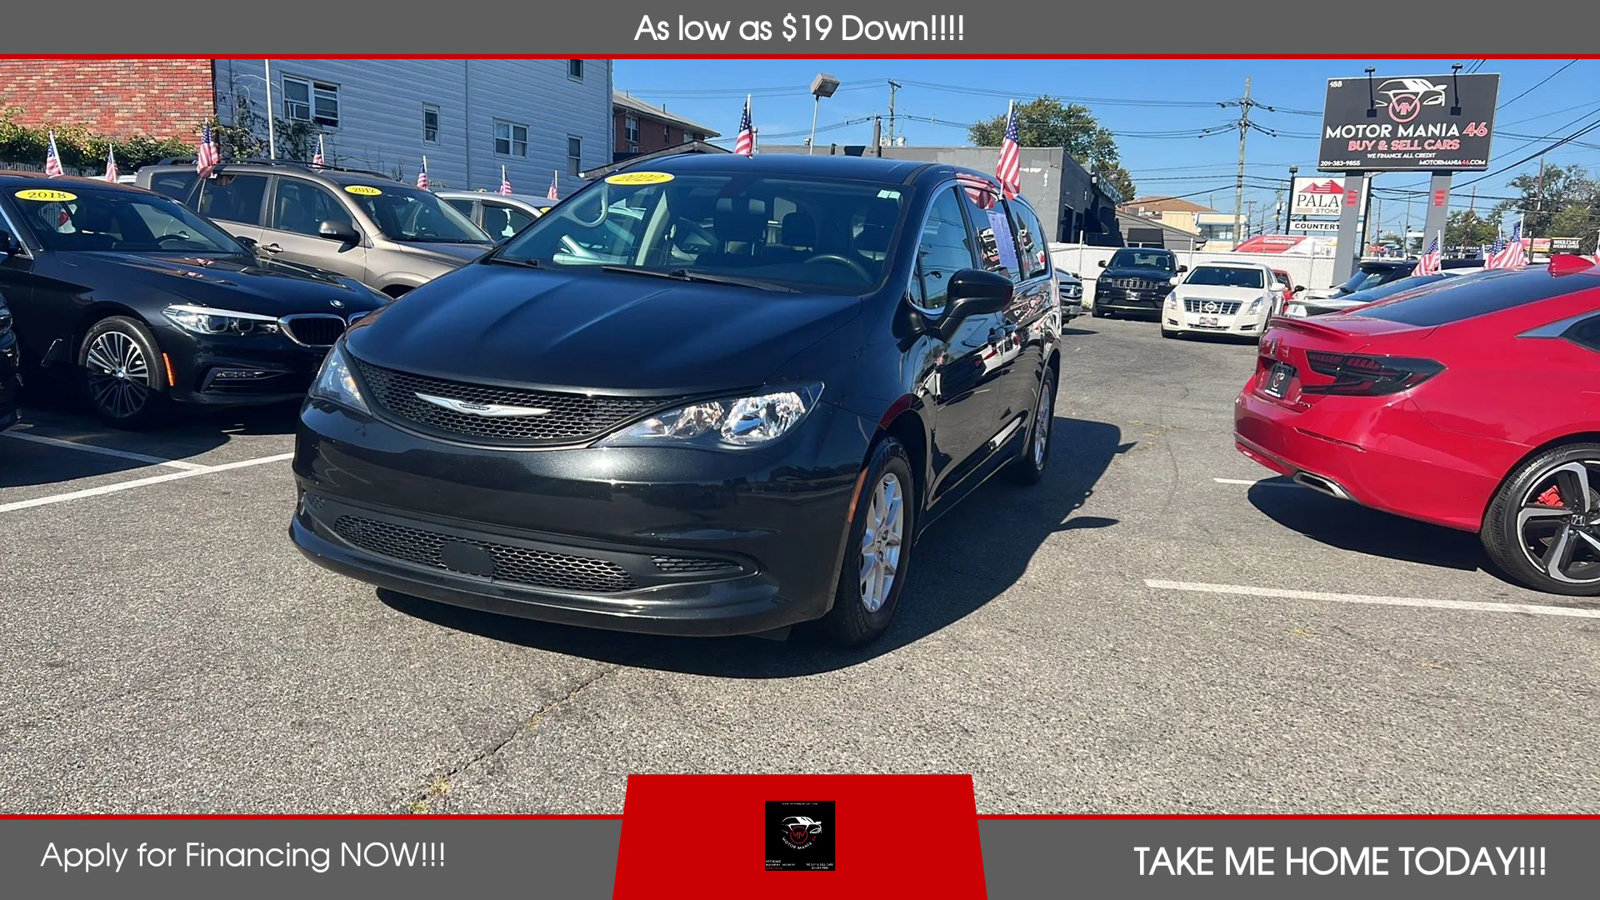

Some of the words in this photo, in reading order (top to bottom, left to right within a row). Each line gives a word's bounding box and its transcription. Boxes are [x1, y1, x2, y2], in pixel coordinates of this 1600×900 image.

[1325, 124, 1392, 139] MOTOR
[1397, 122, 1460, 138] MANIA
[1462, 121, 1488, 137] 46
[1348, 140, 1377, 151] BUY
[1378, 140, 1388, 151] &
[1390, 139, 1422, 151] SELL
[1424, 139, 1460, 150] CARS
[27, 191, 67, 199] 2018
